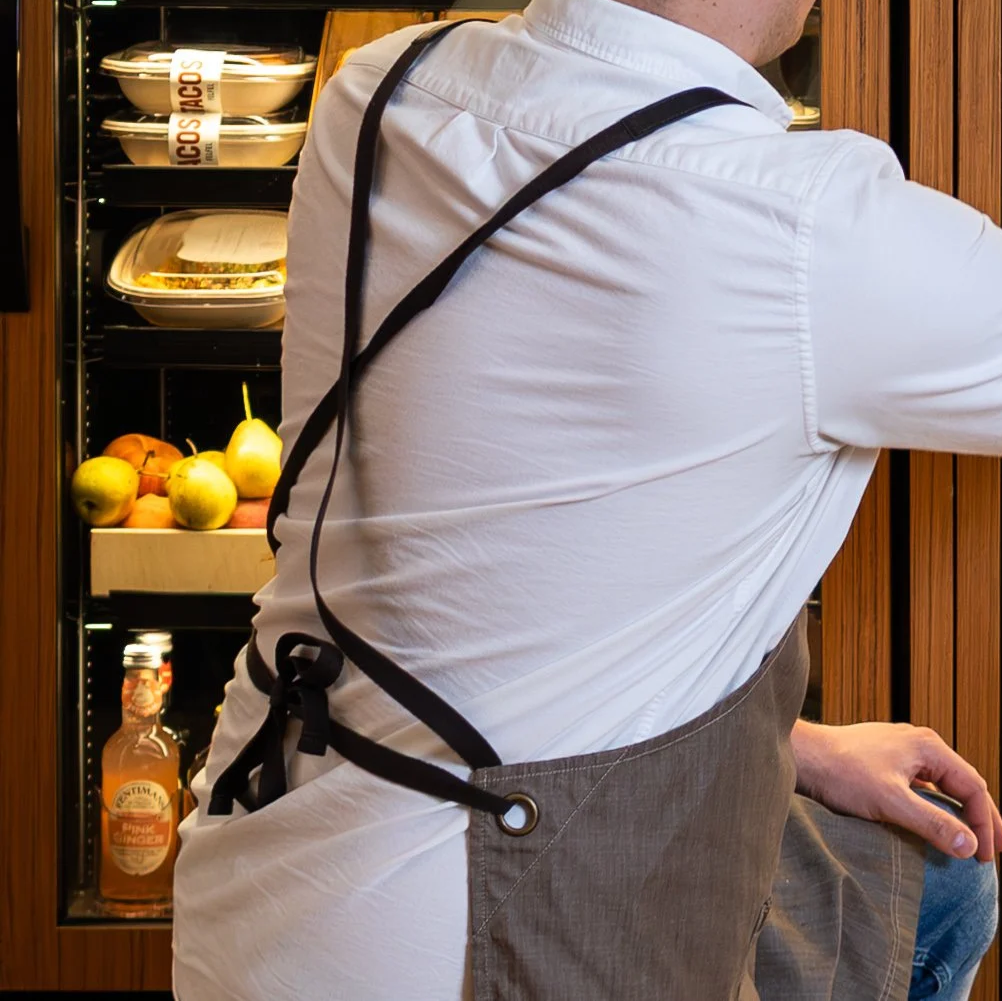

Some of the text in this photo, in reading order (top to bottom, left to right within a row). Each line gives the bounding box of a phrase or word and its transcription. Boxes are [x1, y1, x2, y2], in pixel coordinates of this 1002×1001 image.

[178, 60, 205, 114] TACOS
[176, 119, 202, 166] ACOS
[121, 822, 156, 834] PINK
